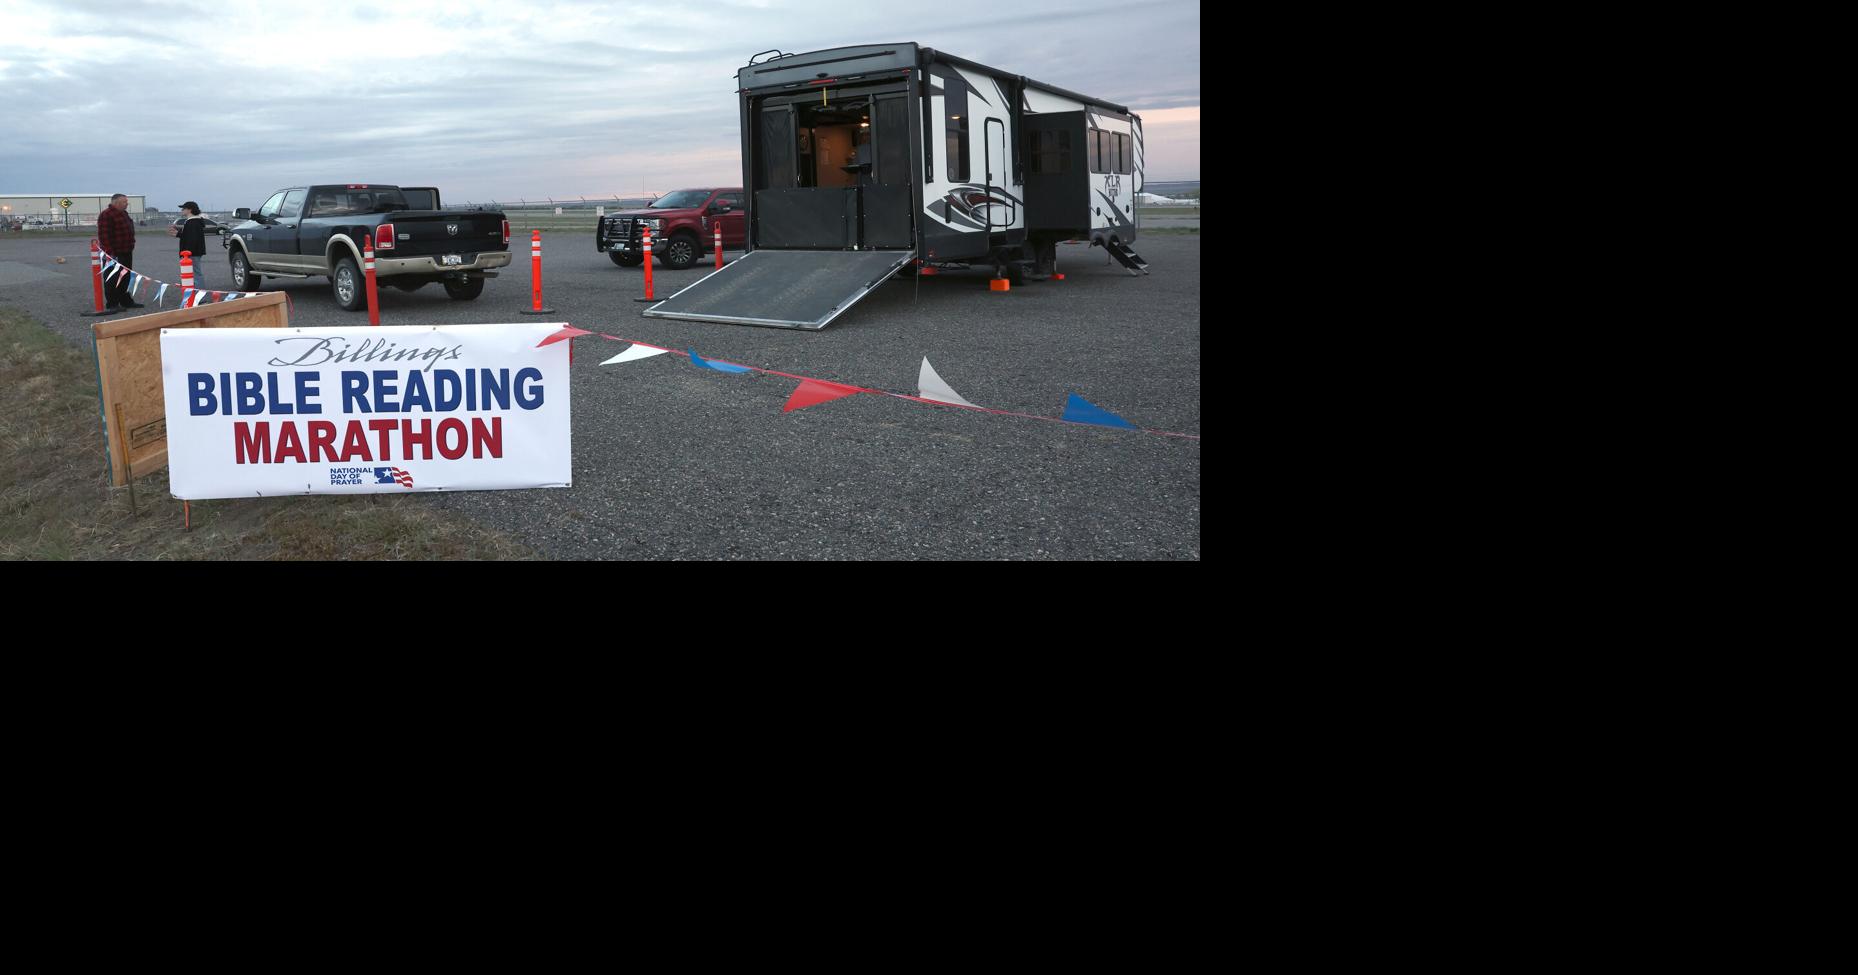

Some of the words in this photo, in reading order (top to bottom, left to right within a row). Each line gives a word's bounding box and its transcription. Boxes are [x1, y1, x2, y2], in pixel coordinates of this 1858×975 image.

[1104, 175, 1121, 192] XLR
[268, 337, 462, 372] Billings
[188, 371, 322, 416] BIBLE
[341, 367, 544, 413] READING
[234, 417, 502, 464] MARATHON
